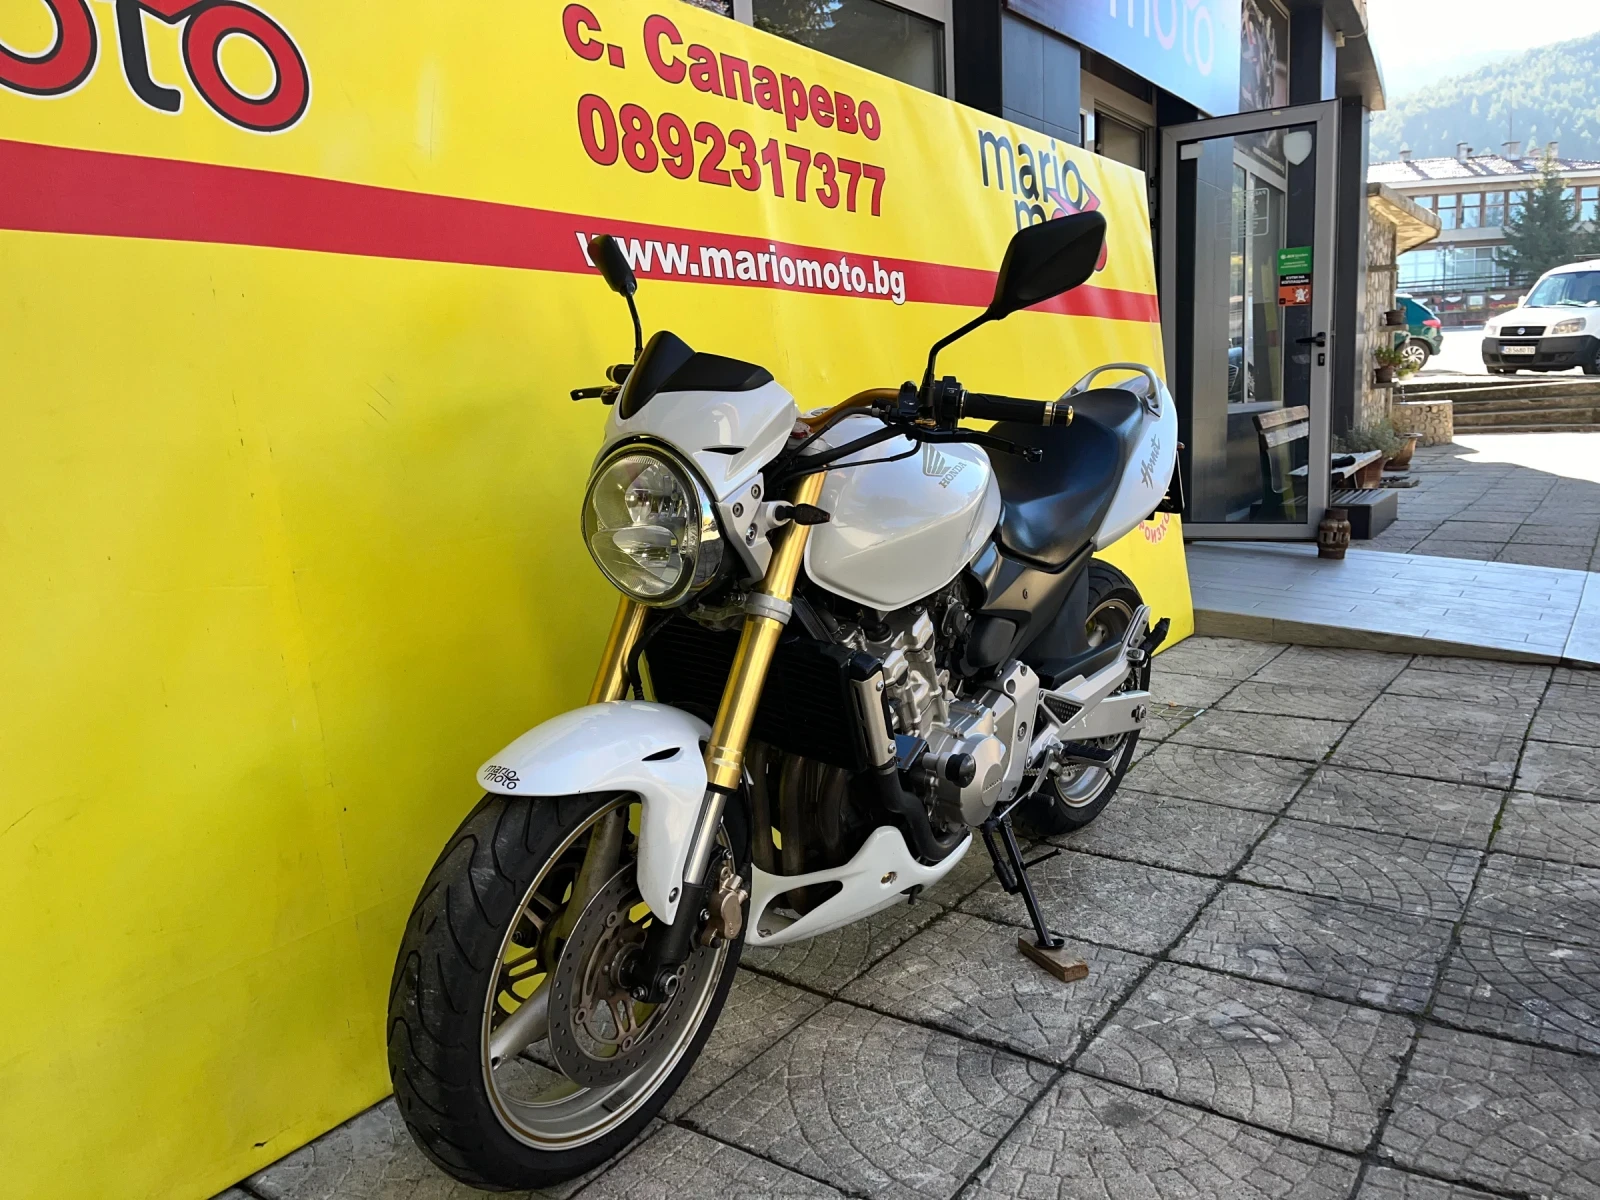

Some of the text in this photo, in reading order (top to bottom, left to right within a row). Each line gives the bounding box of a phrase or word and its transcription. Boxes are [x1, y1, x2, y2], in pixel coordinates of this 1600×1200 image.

[562, 3, 881, 141] с. Сапарево
[577, 93, 886, 217] 0892317377
[978, 129, 1084, 209] mario
[938, 461, 967, 489] HONDA
[1140, 434, 1161, 489] Hornet
[483, 772, 517, 790] moto
[484, 764, 517, 779] mario
